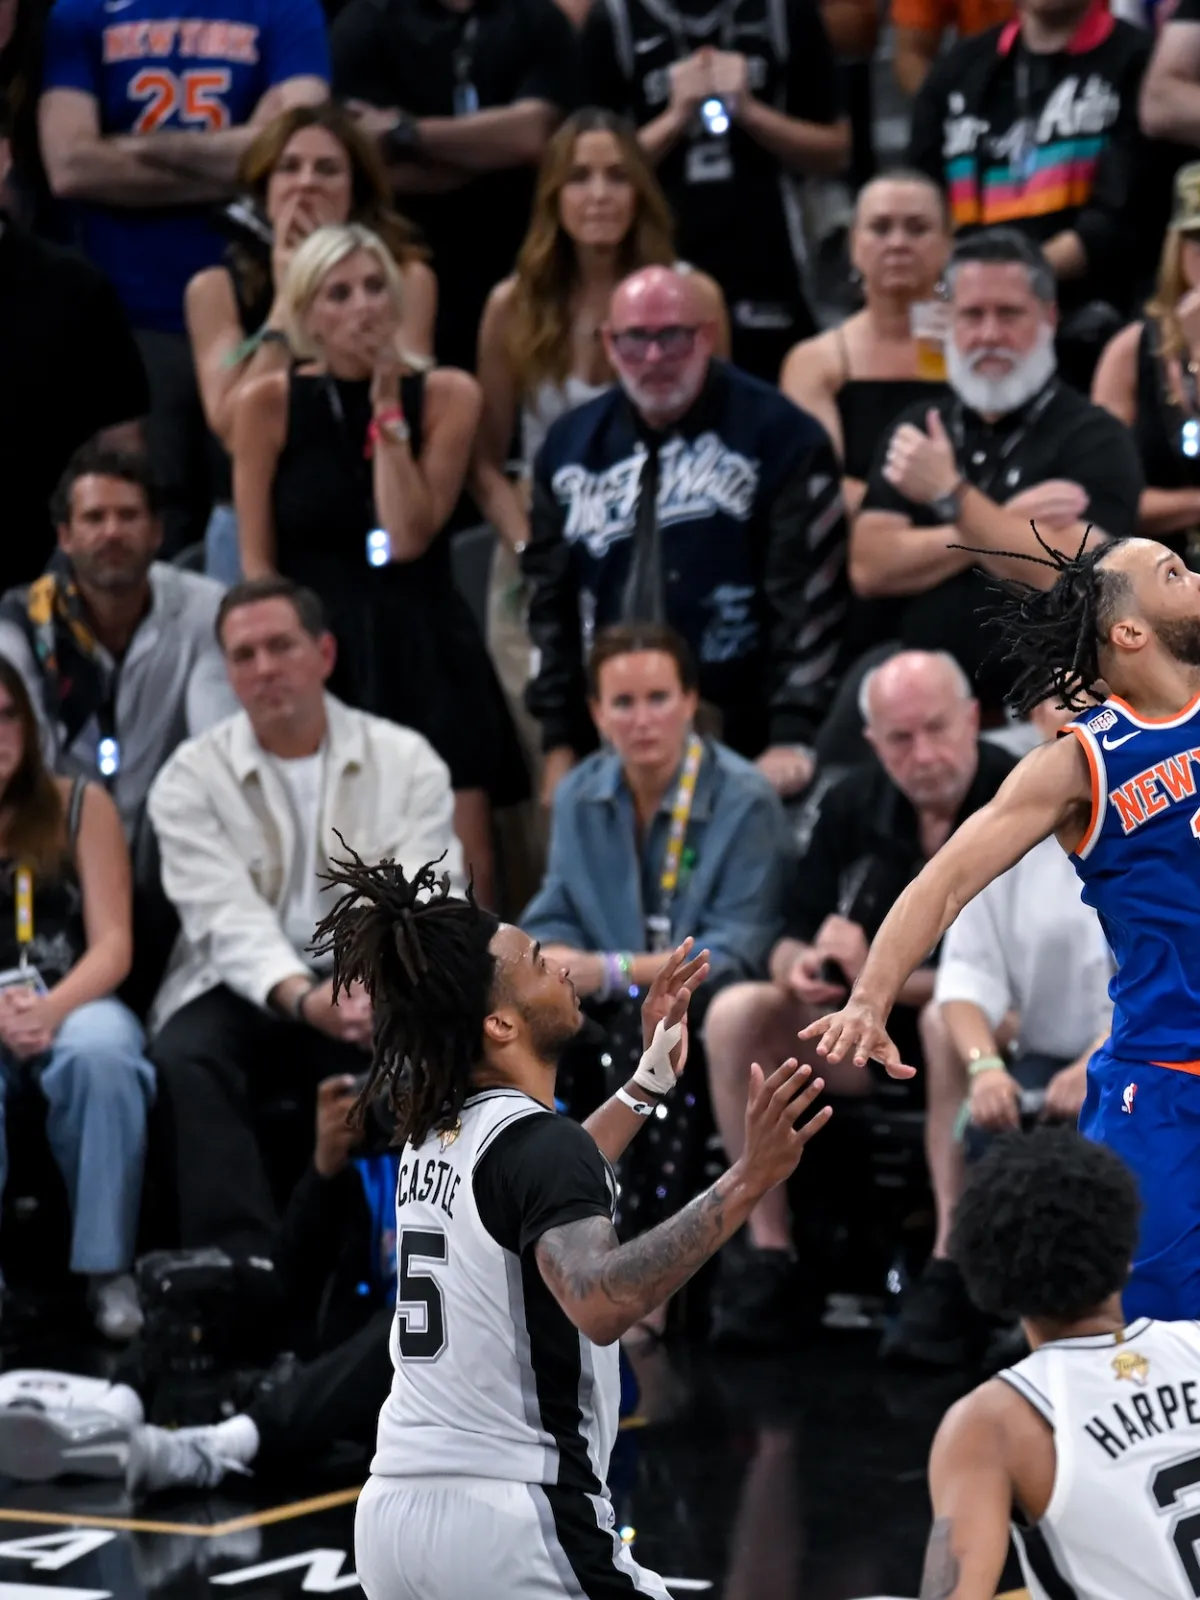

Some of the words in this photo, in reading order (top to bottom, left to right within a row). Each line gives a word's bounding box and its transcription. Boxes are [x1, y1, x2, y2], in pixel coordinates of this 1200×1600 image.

[127, 67, 232, 133] 25
[1108, 750, 1197, 836] NEW
[398, 1159, 461, 1219] CASTLE
[396, 1224, 449, 1363] 5
